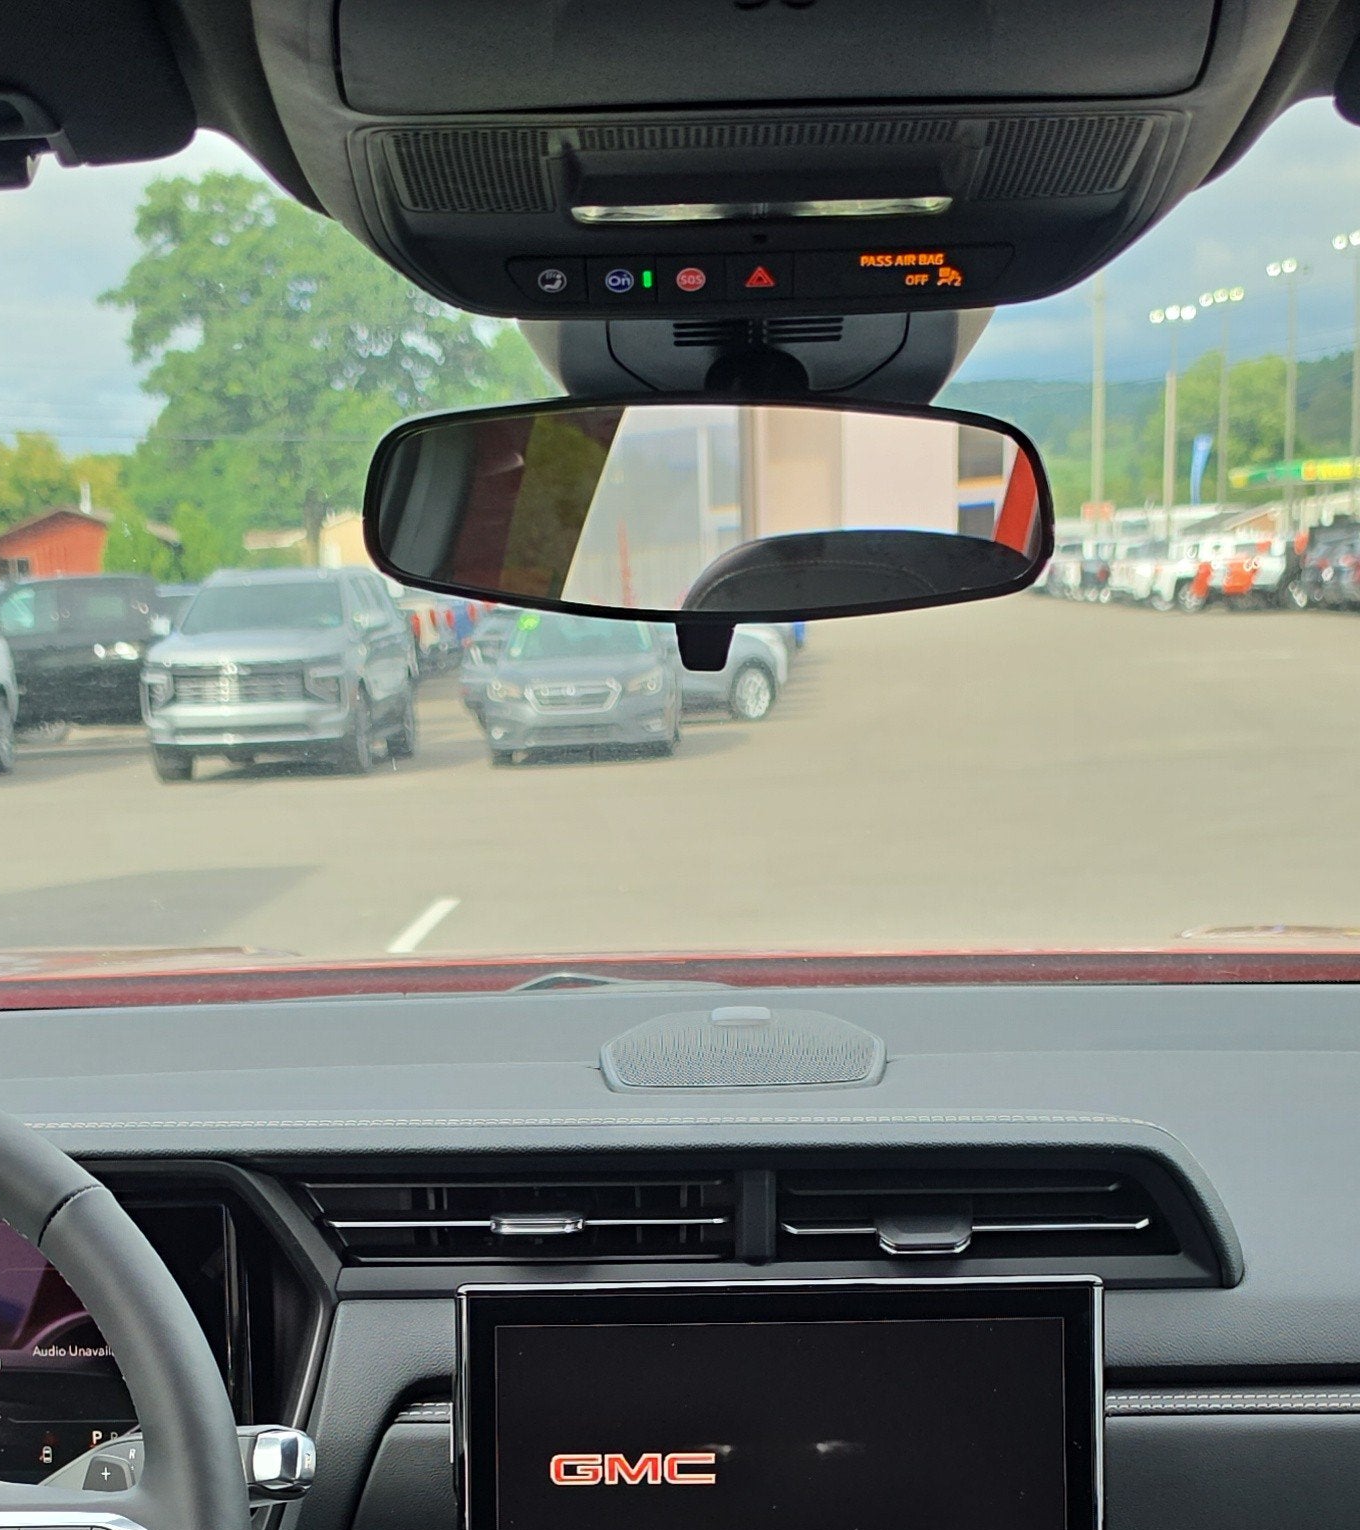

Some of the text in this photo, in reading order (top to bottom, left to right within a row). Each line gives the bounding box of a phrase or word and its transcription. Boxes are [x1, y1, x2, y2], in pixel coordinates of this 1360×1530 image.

[860, 253, 944, 267] PASS AIR BAG
[680, 275, 702, 285] SOS
[905, 274, 929, 286] OFF
[32, 1345, 116, 1357] Audio Unavail
[92, 1431, 103, 1444] P
[129, 1448, 136, 1459] R
[549, 1452, 717, 1486] GMC
